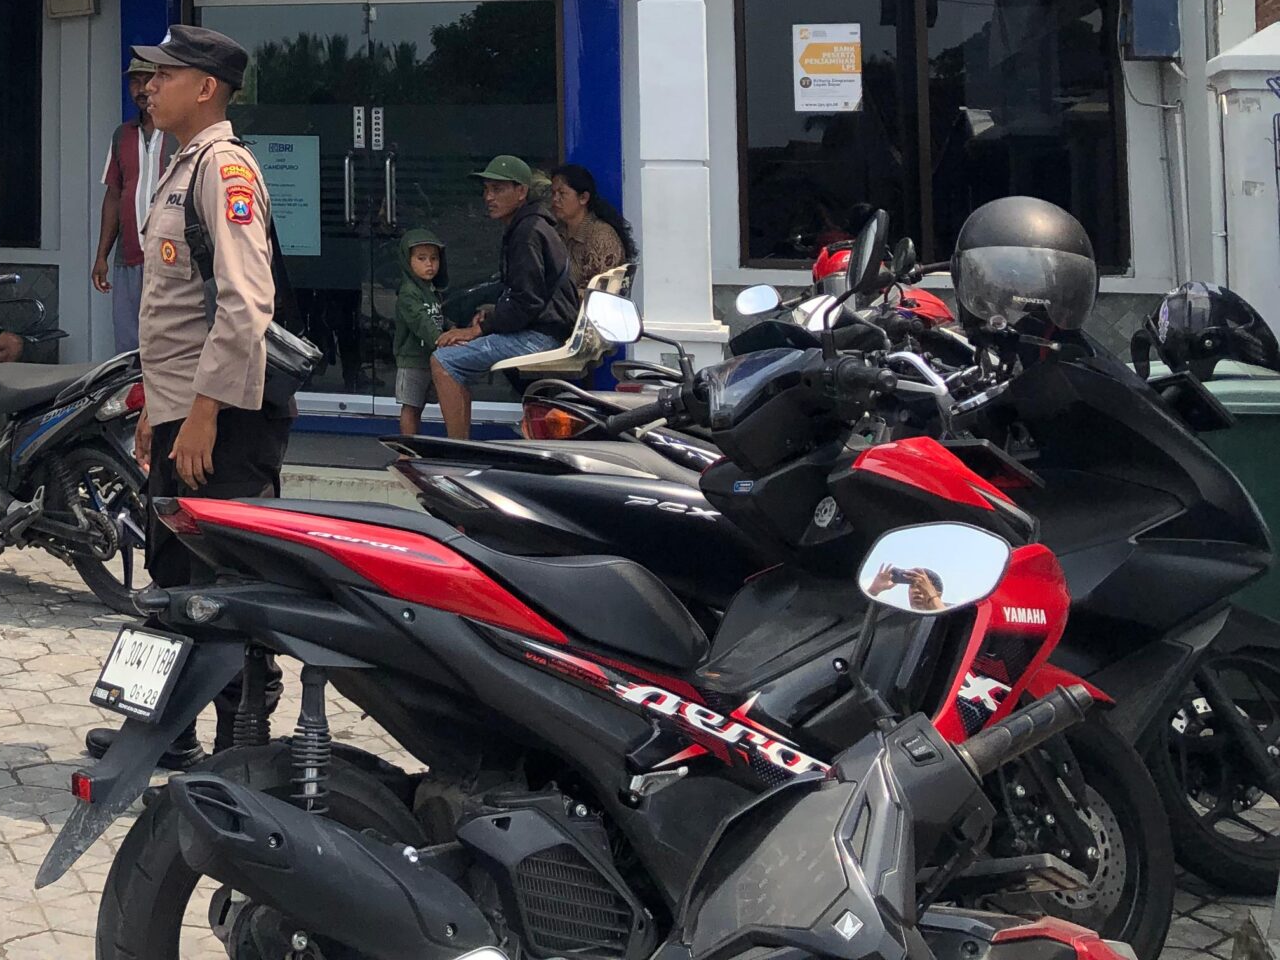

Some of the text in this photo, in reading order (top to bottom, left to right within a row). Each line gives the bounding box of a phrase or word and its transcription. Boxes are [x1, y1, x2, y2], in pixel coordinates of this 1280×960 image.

[278, 144, 294, 152] BRI
[625, 495, 721, 521] PCX
[1003, 606, 1047, 625] YAMAHA
